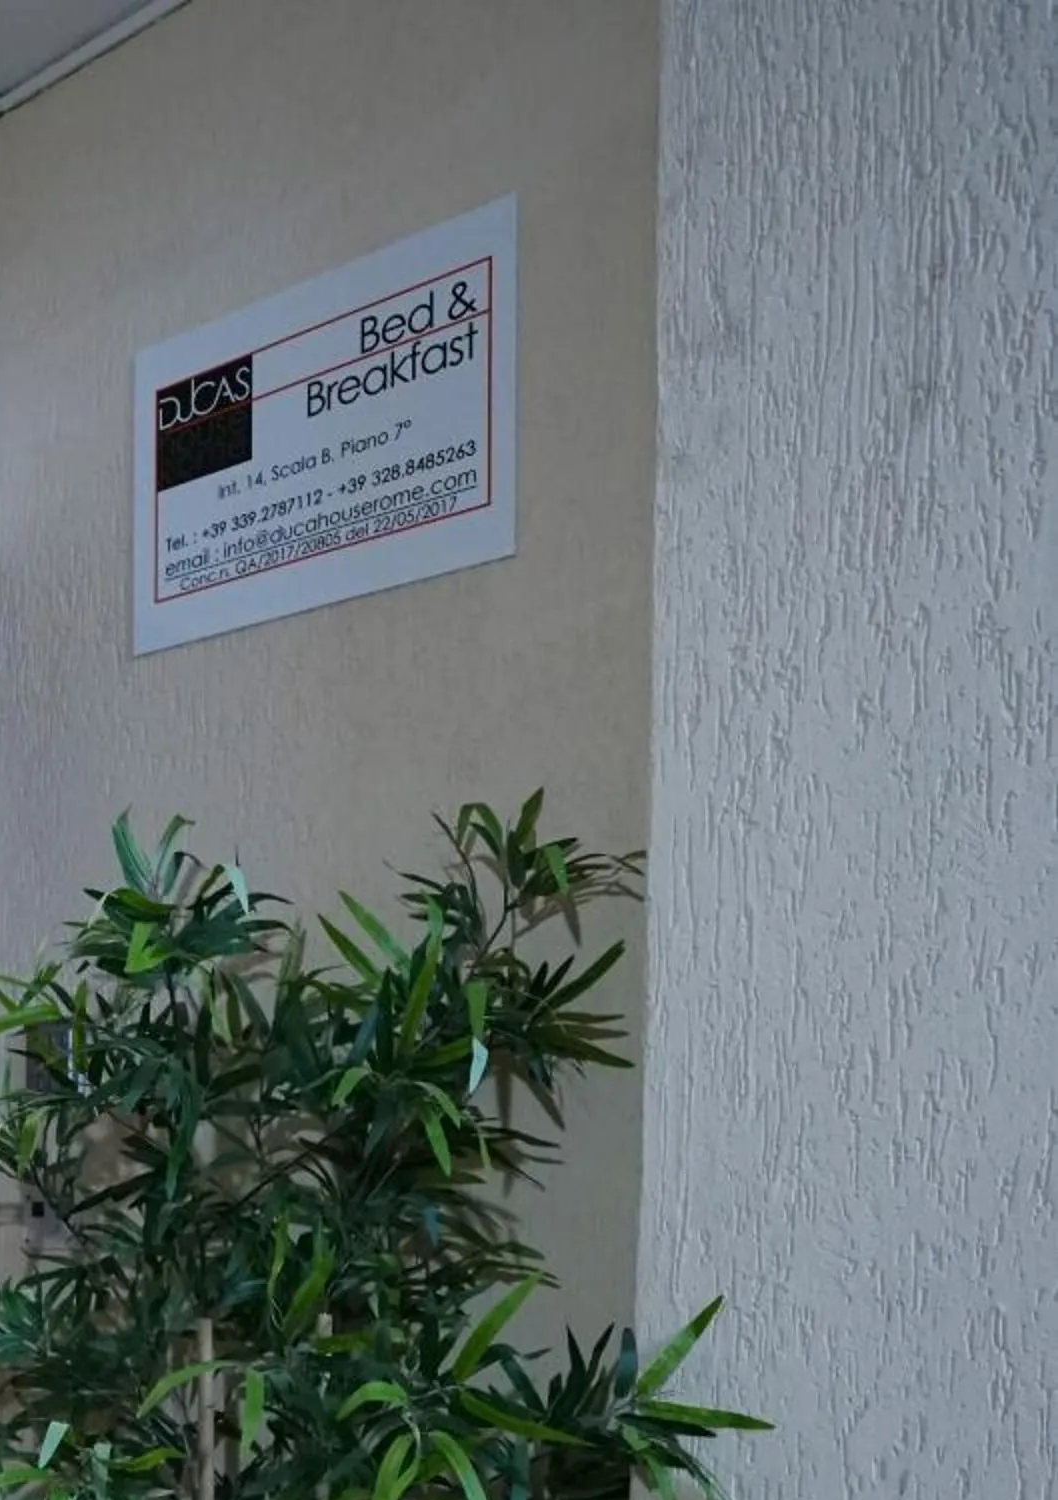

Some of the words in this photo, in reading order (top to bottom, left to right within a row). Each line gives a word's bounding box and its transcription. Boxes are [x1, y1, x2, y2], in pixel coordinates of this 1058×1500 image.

[361, 291, 433, 354] Bed
[448, 281, 477, 320] &
[307, 322, 479, 418] Breakfast
[271, 456, 317, 481] Scala
[341, 432, 389, 457] Piano
[338, 474, 367, 495] +39
